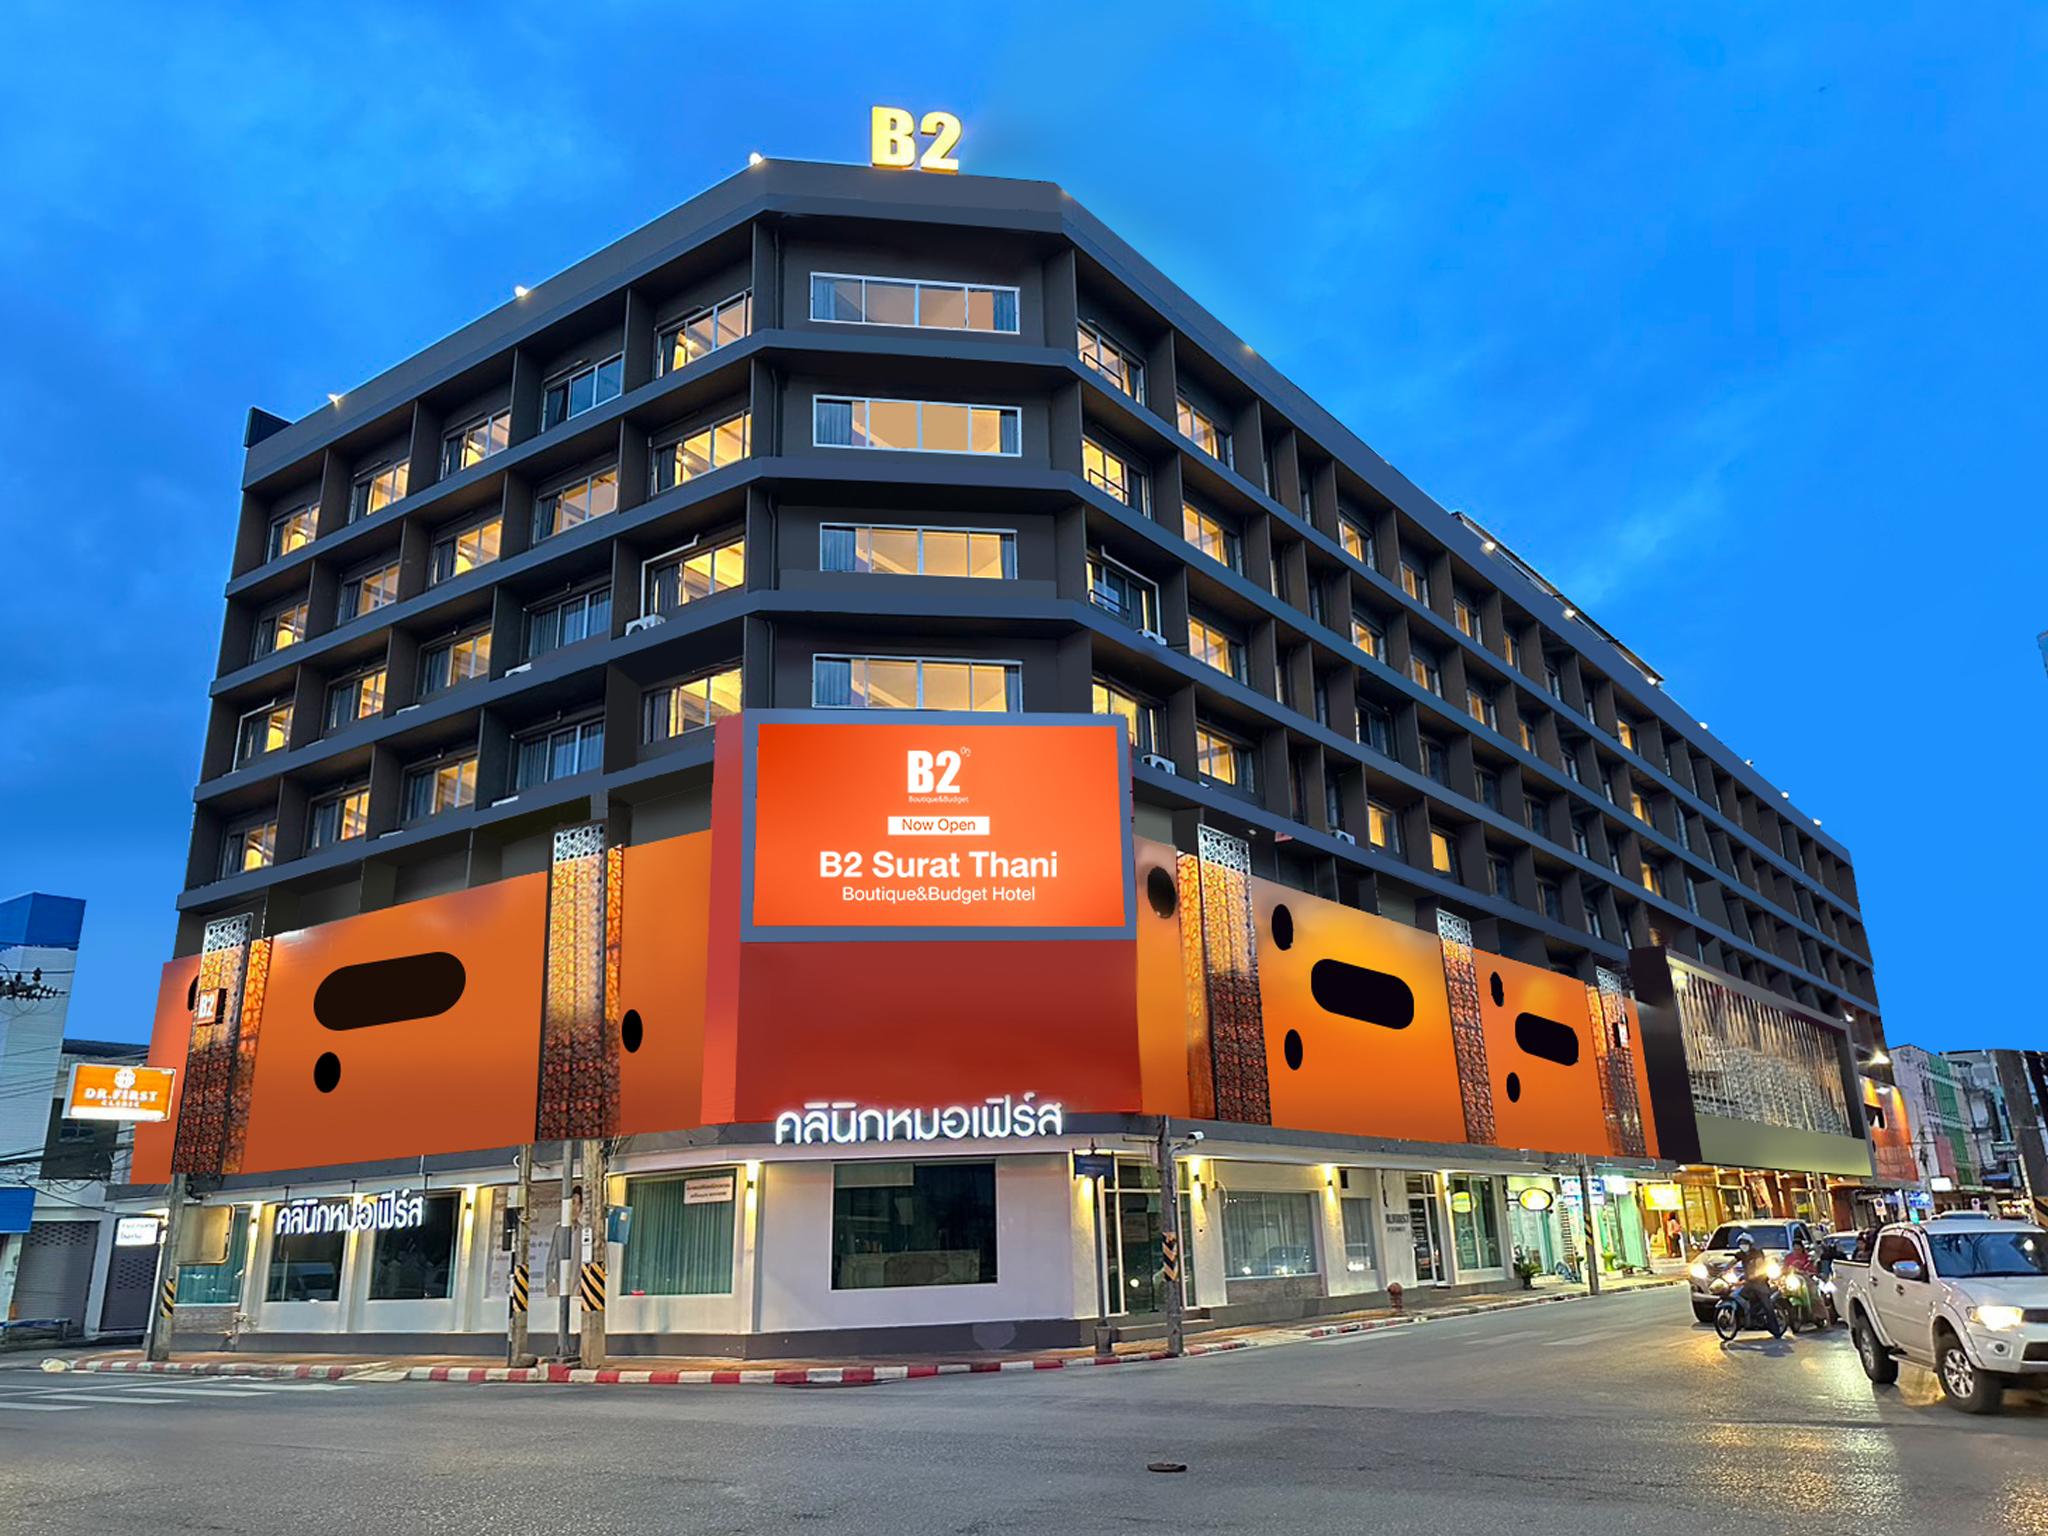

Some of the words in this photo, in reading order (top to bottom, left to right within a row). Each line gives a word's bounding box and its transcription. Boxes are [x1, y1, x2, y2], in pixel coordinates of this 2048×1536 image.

[871, 105, 962, 175] B2
[907, 750, 961, 793] B2
[902, 818, 934, 831] Now
[938, 818, 976, 833] Open
[820, 851, 863, 878] B2
[872, 851, 960, 878] Surat
[969, 851, 1057, 878] Thani
[842, 886, 988, 904] Boutique&Budget
[992, 886, 1035, 901] Hotel
[198, 993, 215, 1018] B2
[775, 1092, 1062, 1145] คลินิกหมอเฟิร์ส
[275, 1188, 424, 1234] คลินิกหมอเฟิร์ส
